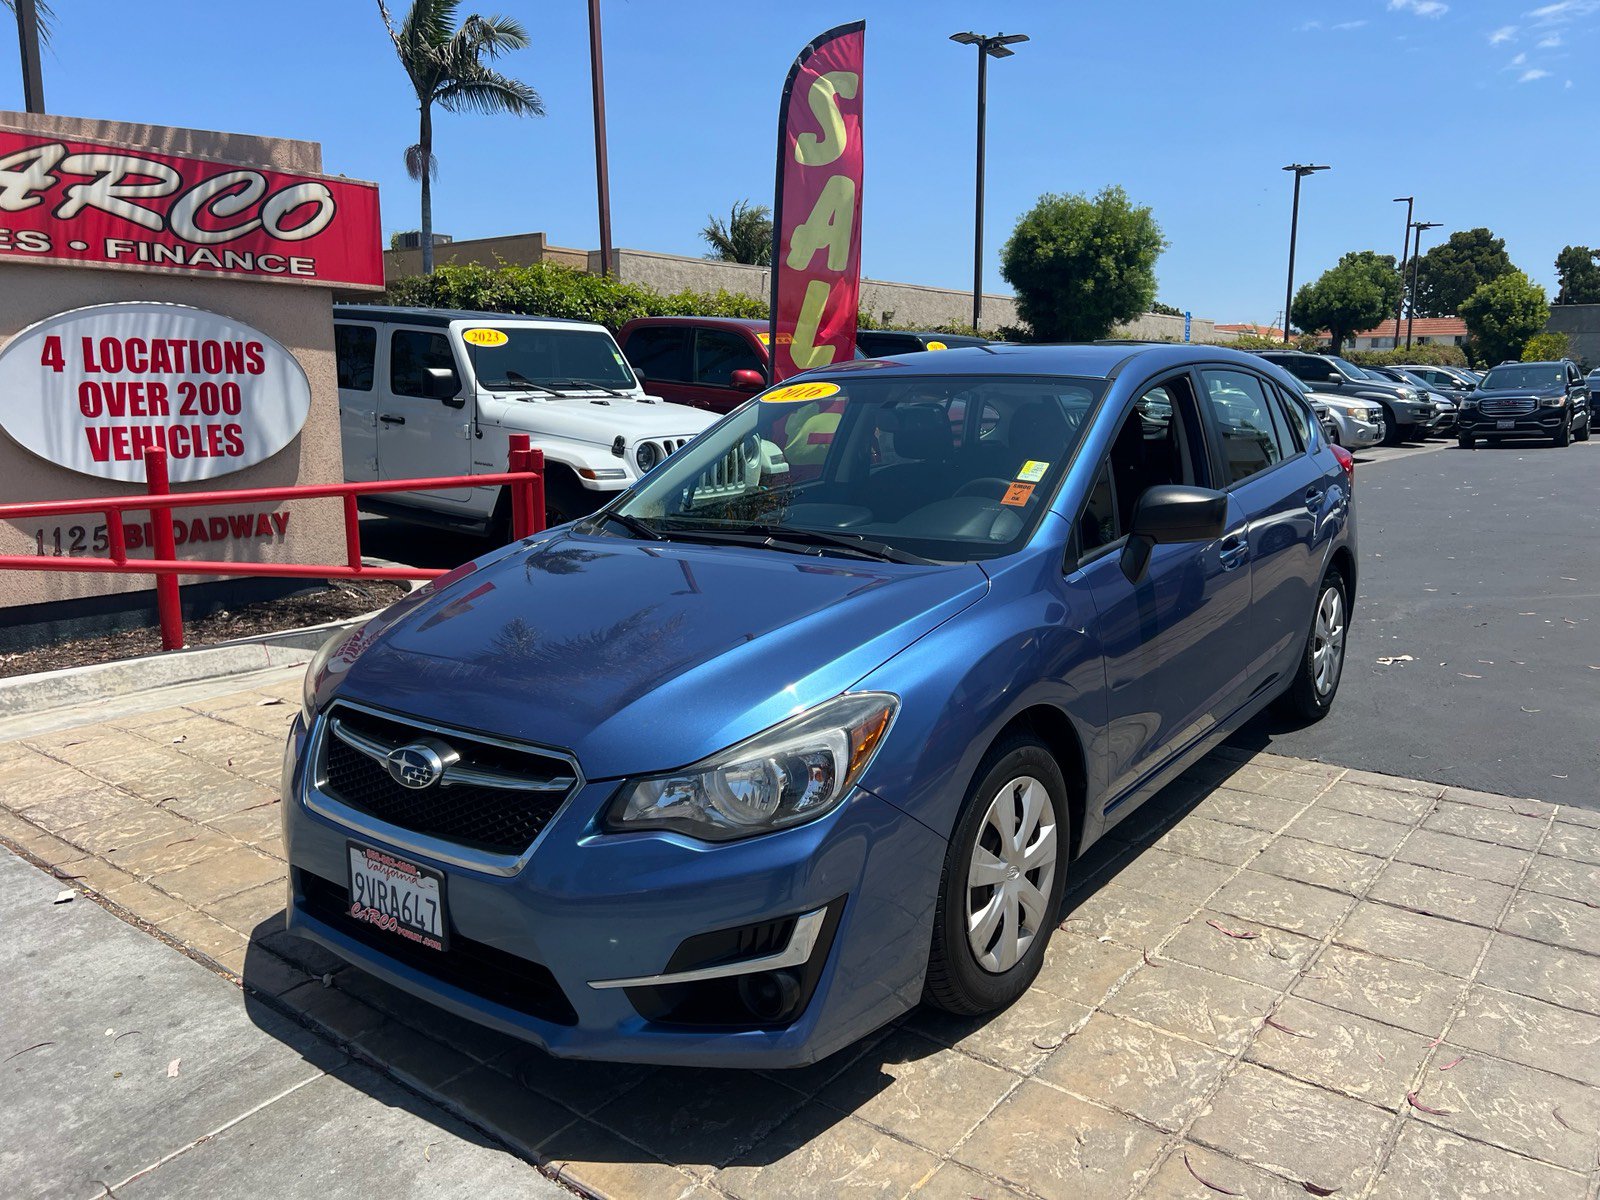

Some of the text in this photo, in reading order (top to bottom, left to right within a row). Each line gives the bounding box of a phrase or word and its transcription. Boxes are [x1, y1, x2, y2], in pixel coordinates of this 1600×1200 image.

[105, 238, 316, 277] FINANCE
[41, 335, 266, 376] 4 LOCATIONS
[472, 331, 499, 342] 2023
[78, 381, 243, 418] OVER 200
[85, 424, 246, 463] VEHICLES
[35, 525, 110, 557] 1125
[355, 871, 437, 936] 9VRA647
